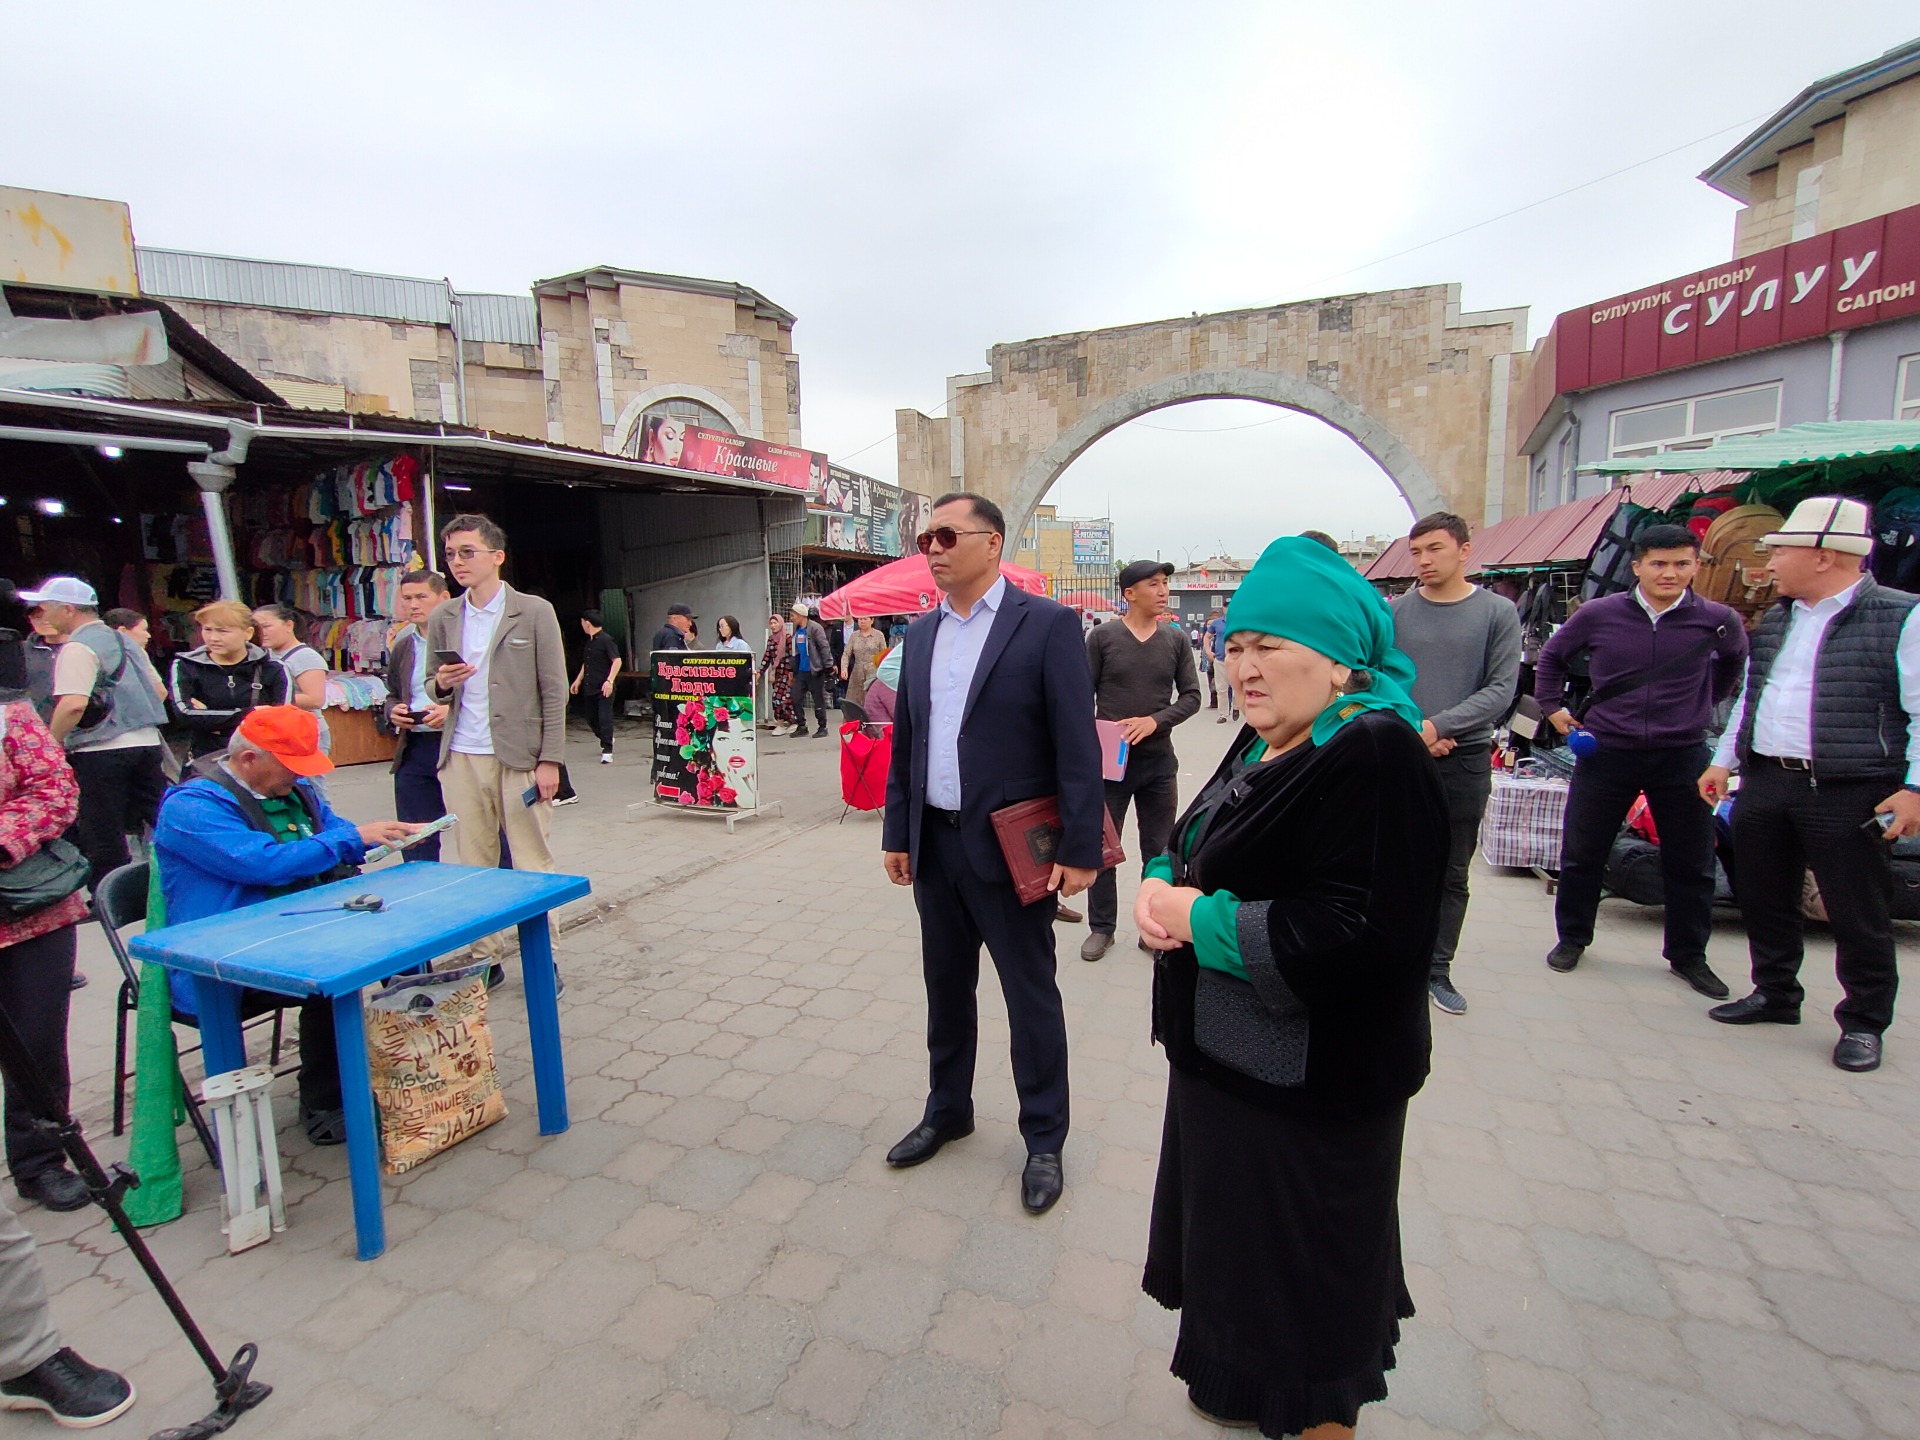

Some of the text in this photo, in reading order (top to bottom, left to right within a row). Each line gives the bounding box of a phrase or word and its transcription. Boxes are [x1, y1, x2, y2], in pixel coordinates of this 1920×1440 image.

[1591, 265, 1756, 324] СУЛУУЛУК САЛОНУ
[1663, 250, 1877, 335] СУЛУУ
[1836, 280, 1916, 313] САЛОН
[713, 445, 778, 472] Красивые
[657, 662, 737, 679] Красивые
[671, 678, 716, 695] Люди
[379, 1024, 413, 1068] FUNK
[384, 1088, 413, 1110] DUB
[420, 1078, 447, 1096] ROCK
[431, 1090, 463, 1115] INDIE
[402, 1108, 429, 1145] FUNK
[441, 1102, 486, 1146] JAZZ
